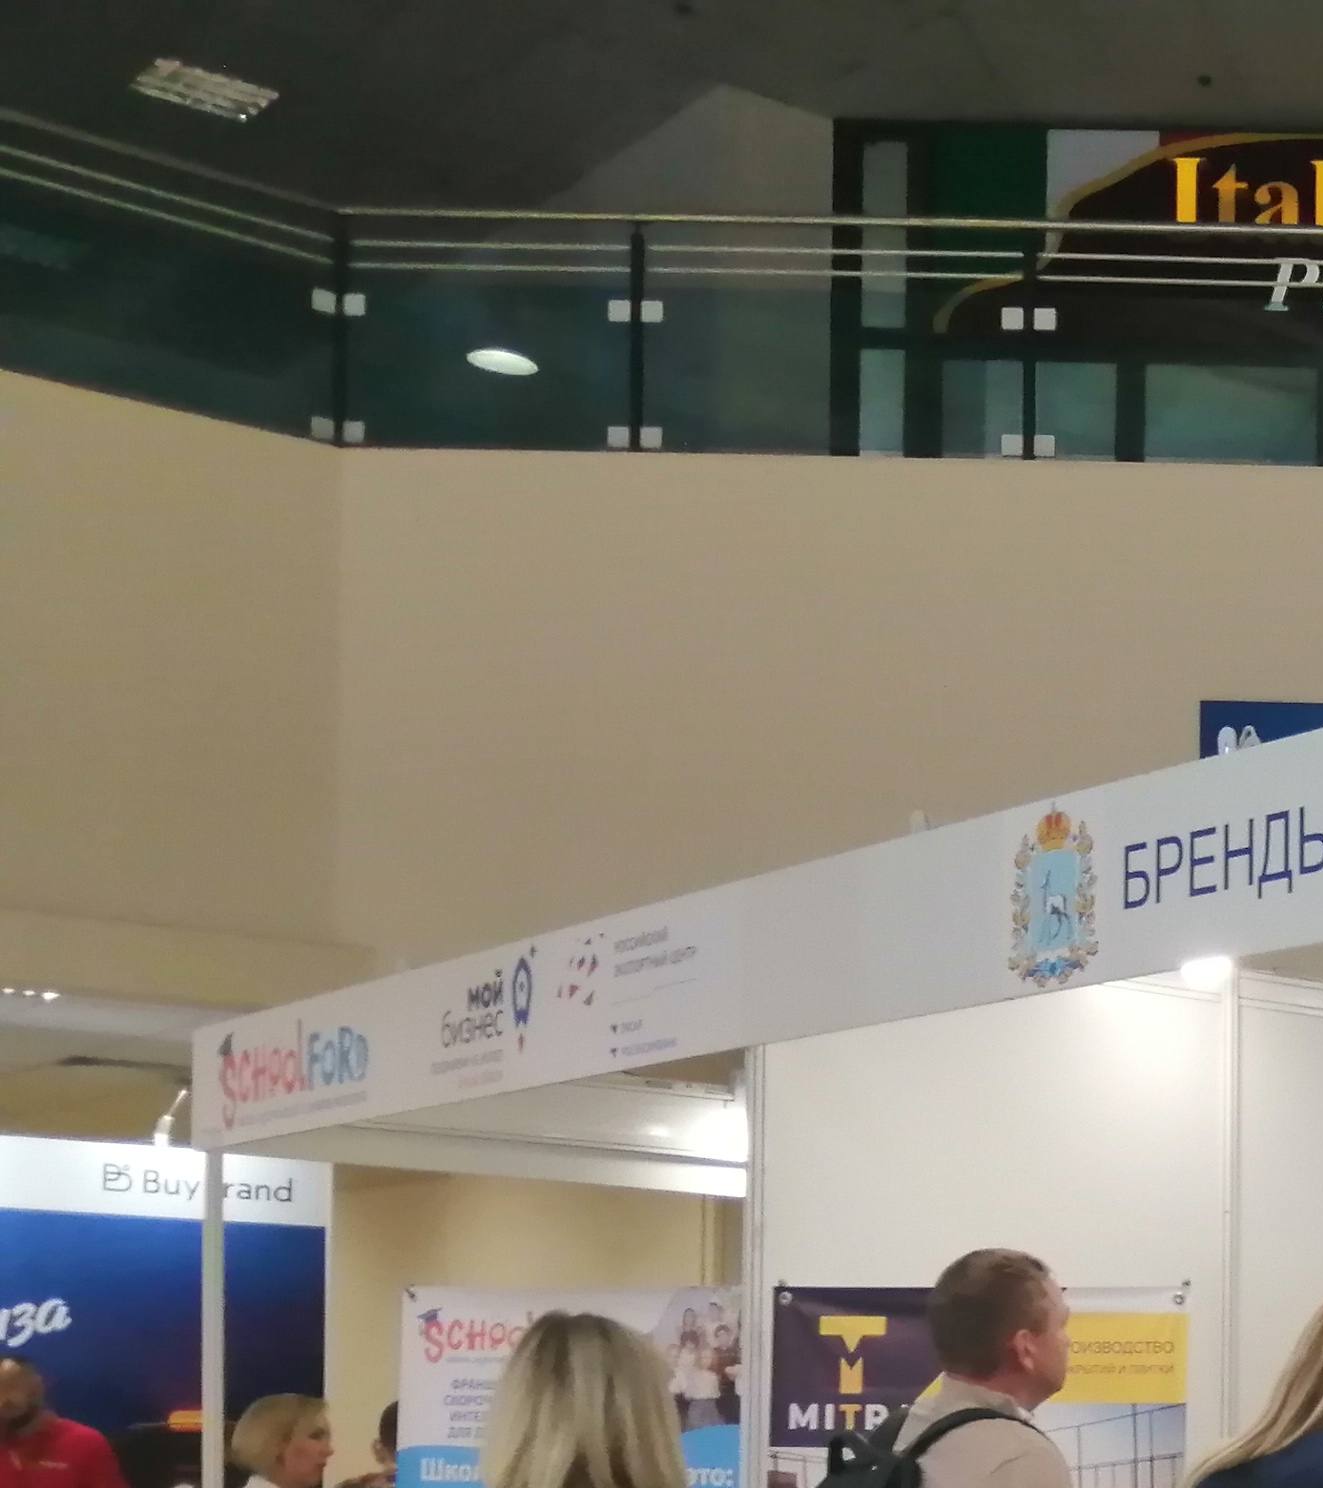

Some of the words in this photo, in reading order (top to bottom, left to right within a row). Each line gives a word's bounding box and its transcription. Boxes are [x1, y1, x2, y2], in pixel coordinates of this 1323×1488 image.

[467, 968, 504, 1012] мой
[441, 1009, 504, 1049] бизнес
[143, 1168, 293, 1204] Buyrand
